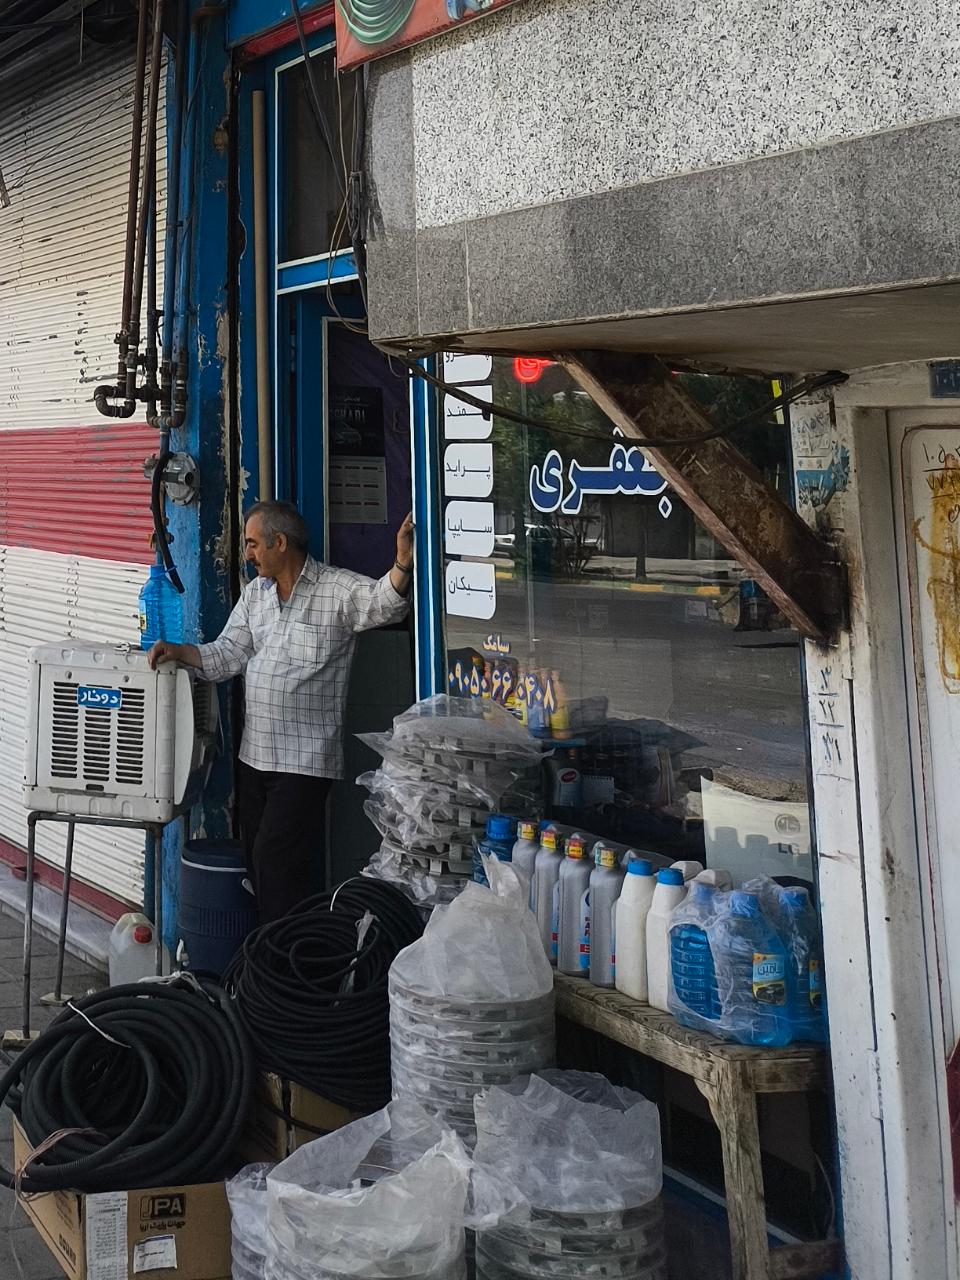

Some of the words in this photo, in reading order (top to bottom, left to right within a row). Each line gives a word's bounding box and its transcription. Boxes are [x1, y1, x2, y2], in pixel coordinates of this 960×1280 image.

[446, 458, 491, 480] پراید
[448, 518, 493, 539] سایپا
[448, 576, 494, 601] پیکان
[483, 632, 511, 657] سیامک
[80, 689, 120, 705] دونار
